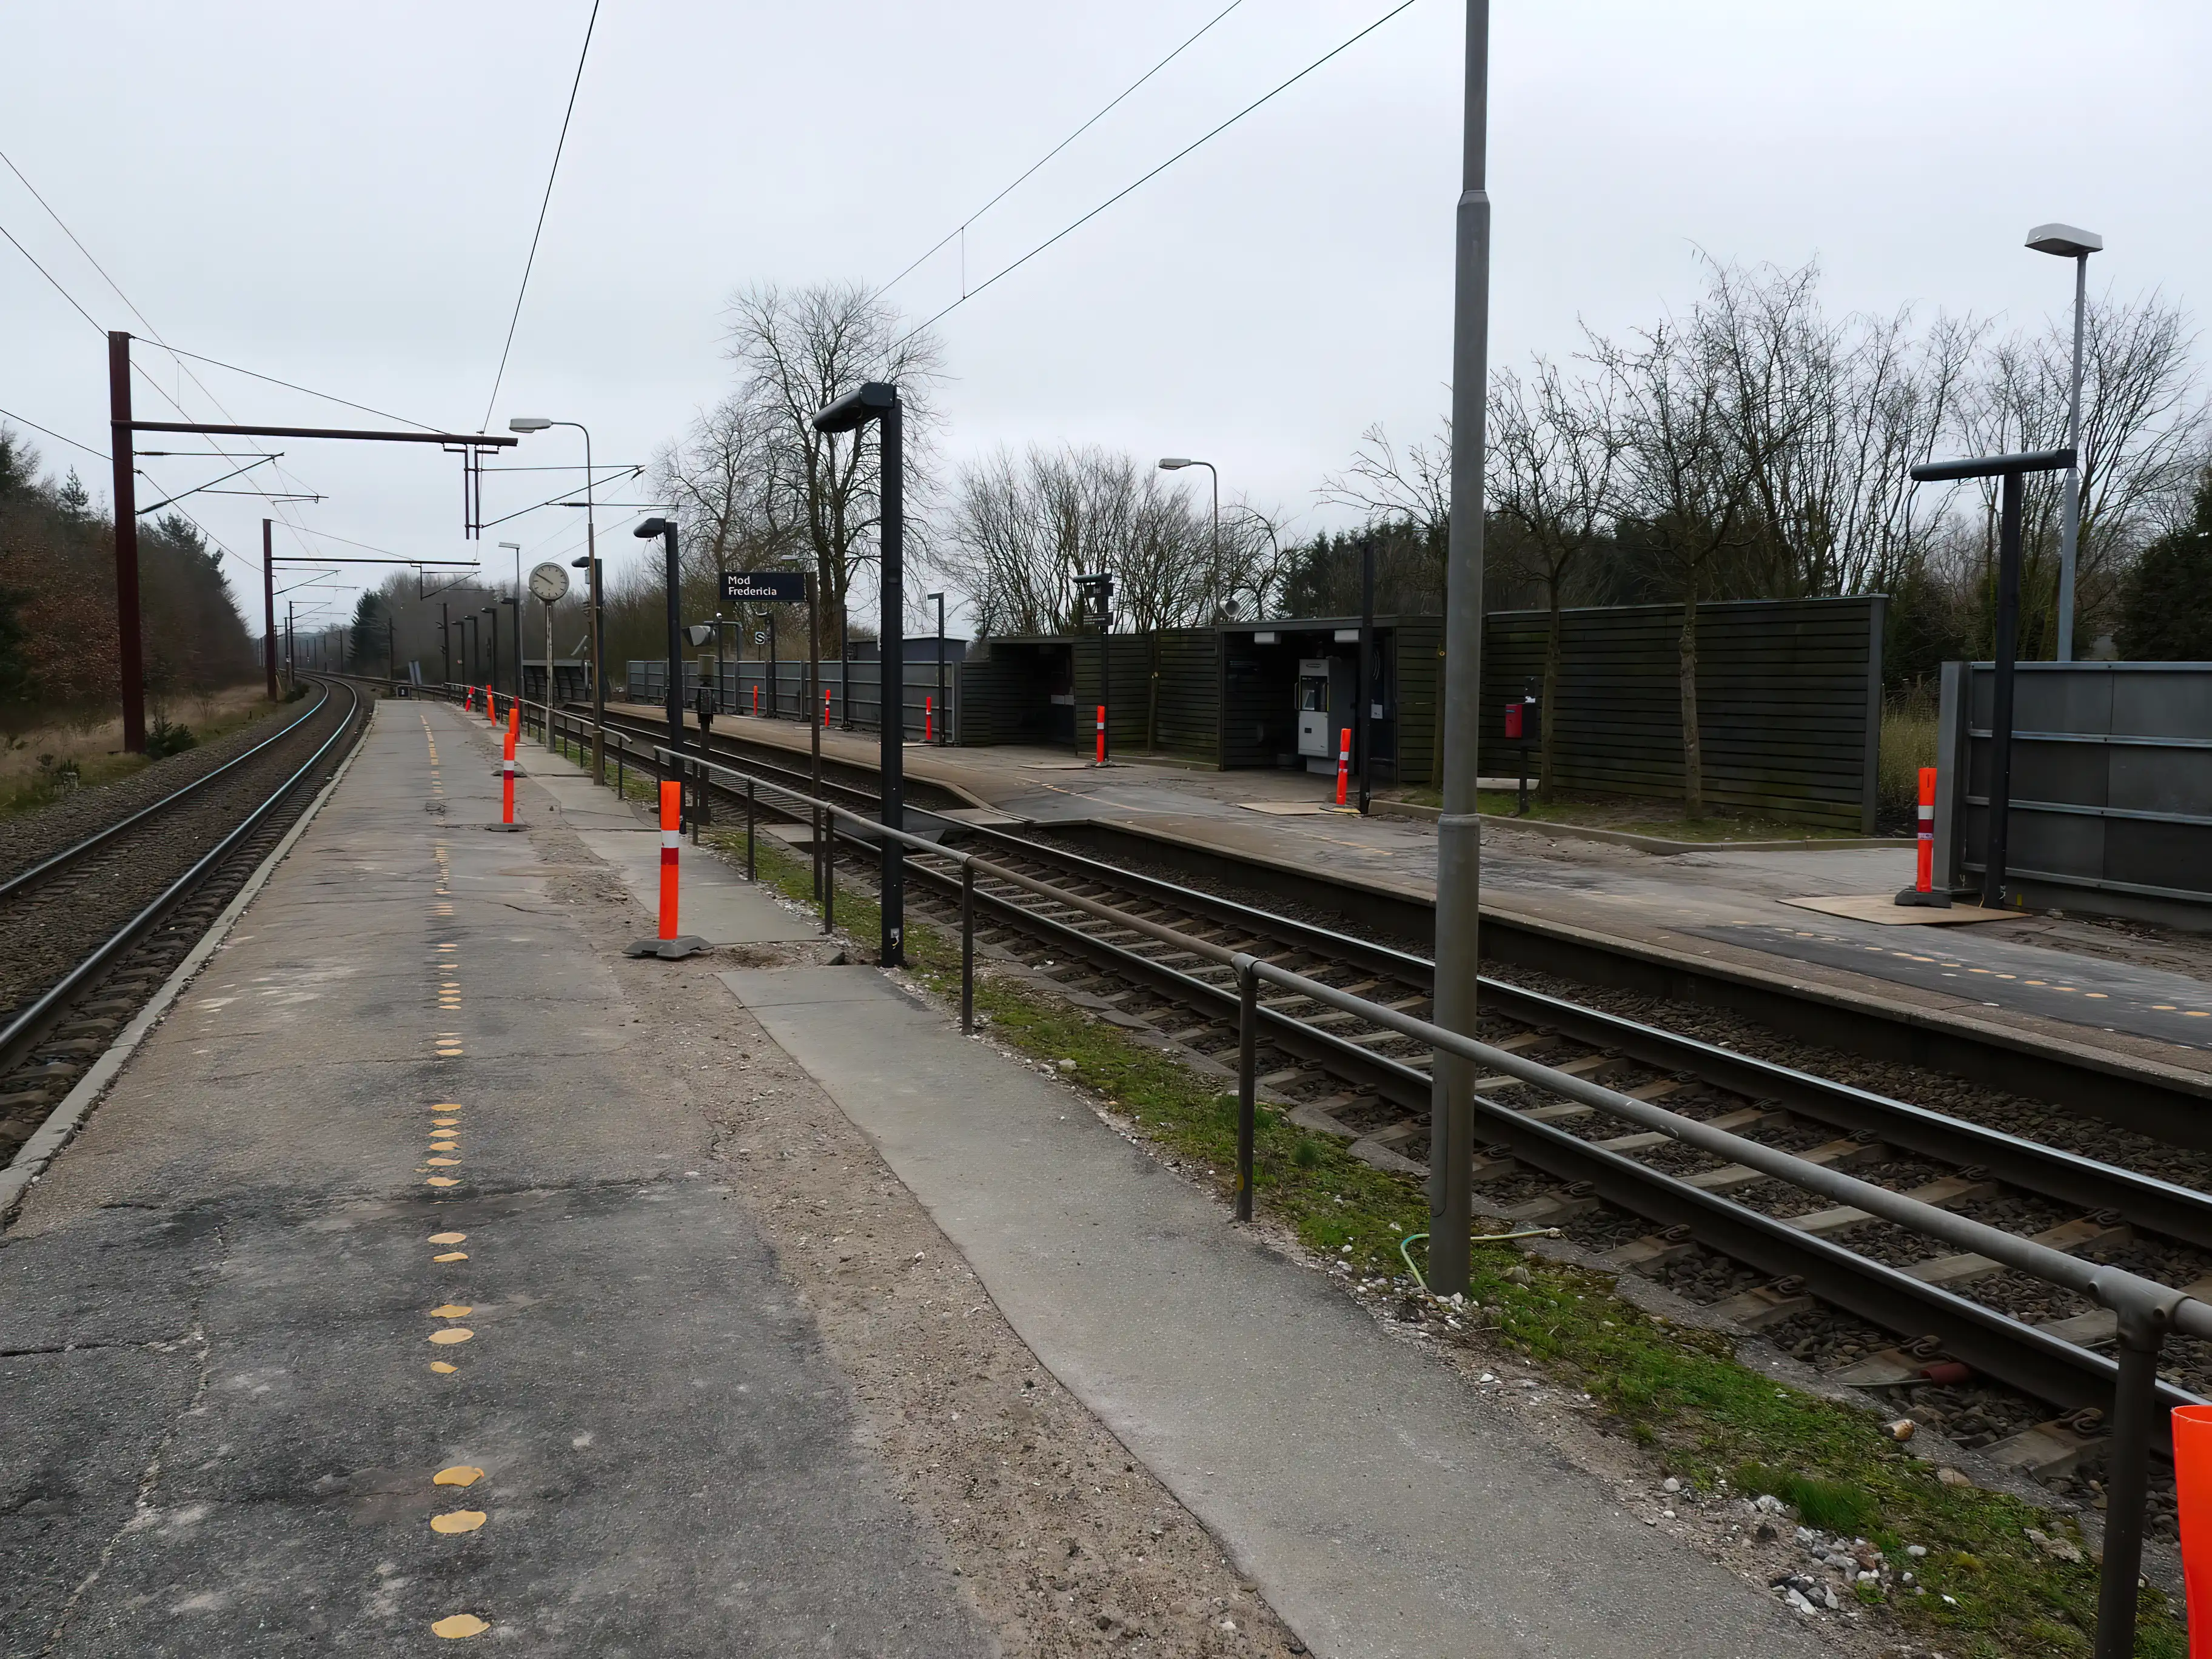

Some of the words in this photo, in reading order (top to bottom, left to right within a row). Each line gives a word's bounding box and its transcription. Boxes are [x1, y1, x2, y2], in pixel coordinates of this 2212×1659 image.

[728, 576, 751, 585] Mod
[728, 587, 777, 595] Fredericia
[756, 633, 765, 643] S
